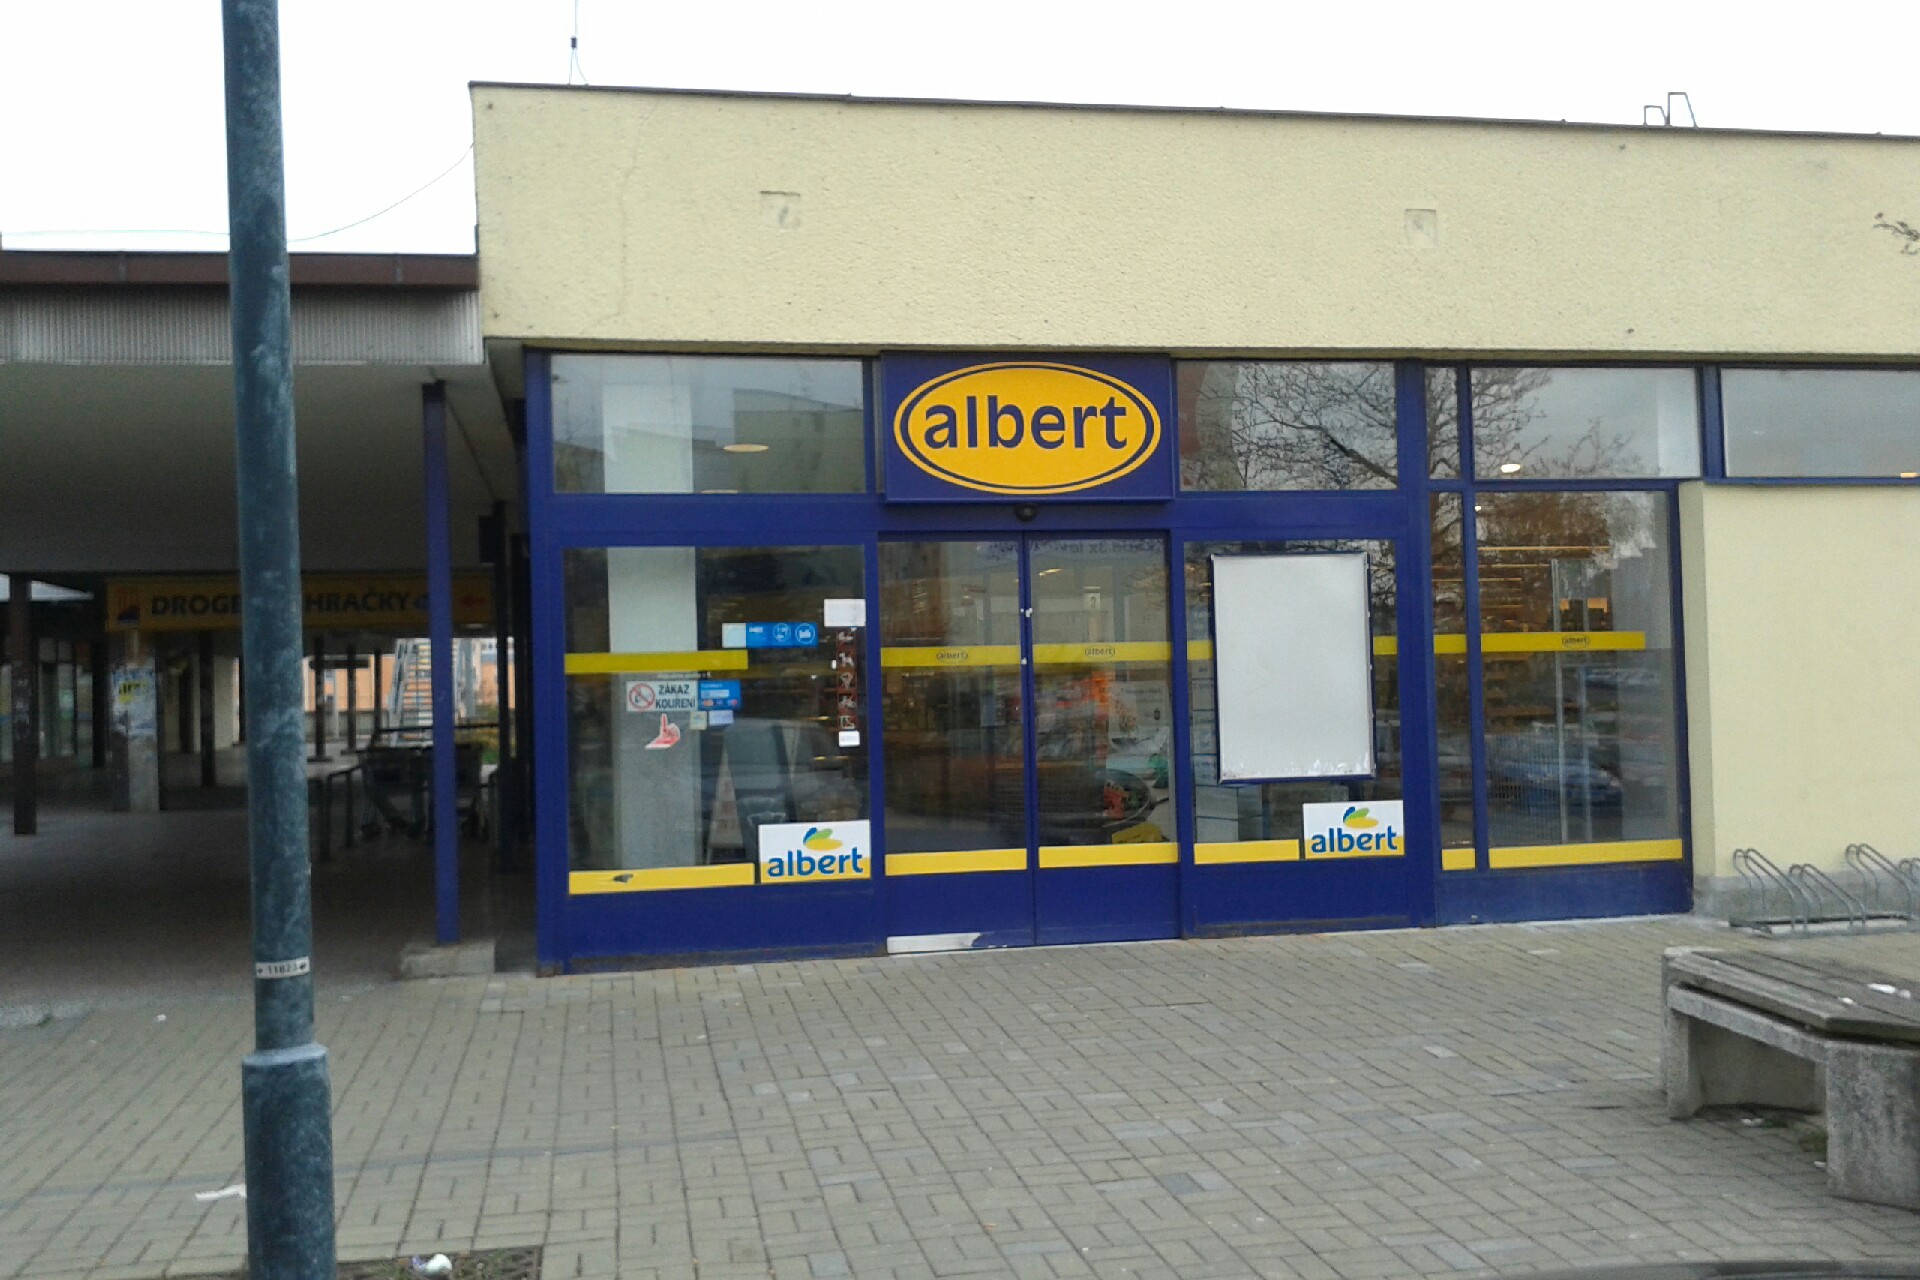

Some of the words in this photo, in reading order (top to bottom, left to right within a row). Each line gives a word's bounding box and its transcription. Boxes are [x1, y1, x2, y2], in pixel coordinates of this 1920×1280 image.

[924, 394, 1128, 449] albert
[151, 595, 242, 616] DROGE
[303, 588, 411, 612] HRAČKY
[655, 696, 696, 709] KOUŘENÍ
[658, 682, 690, 695] ZÁKAZ
[1311, 825, 1398, 853] albert
[767, 846, 864, 877] albert
